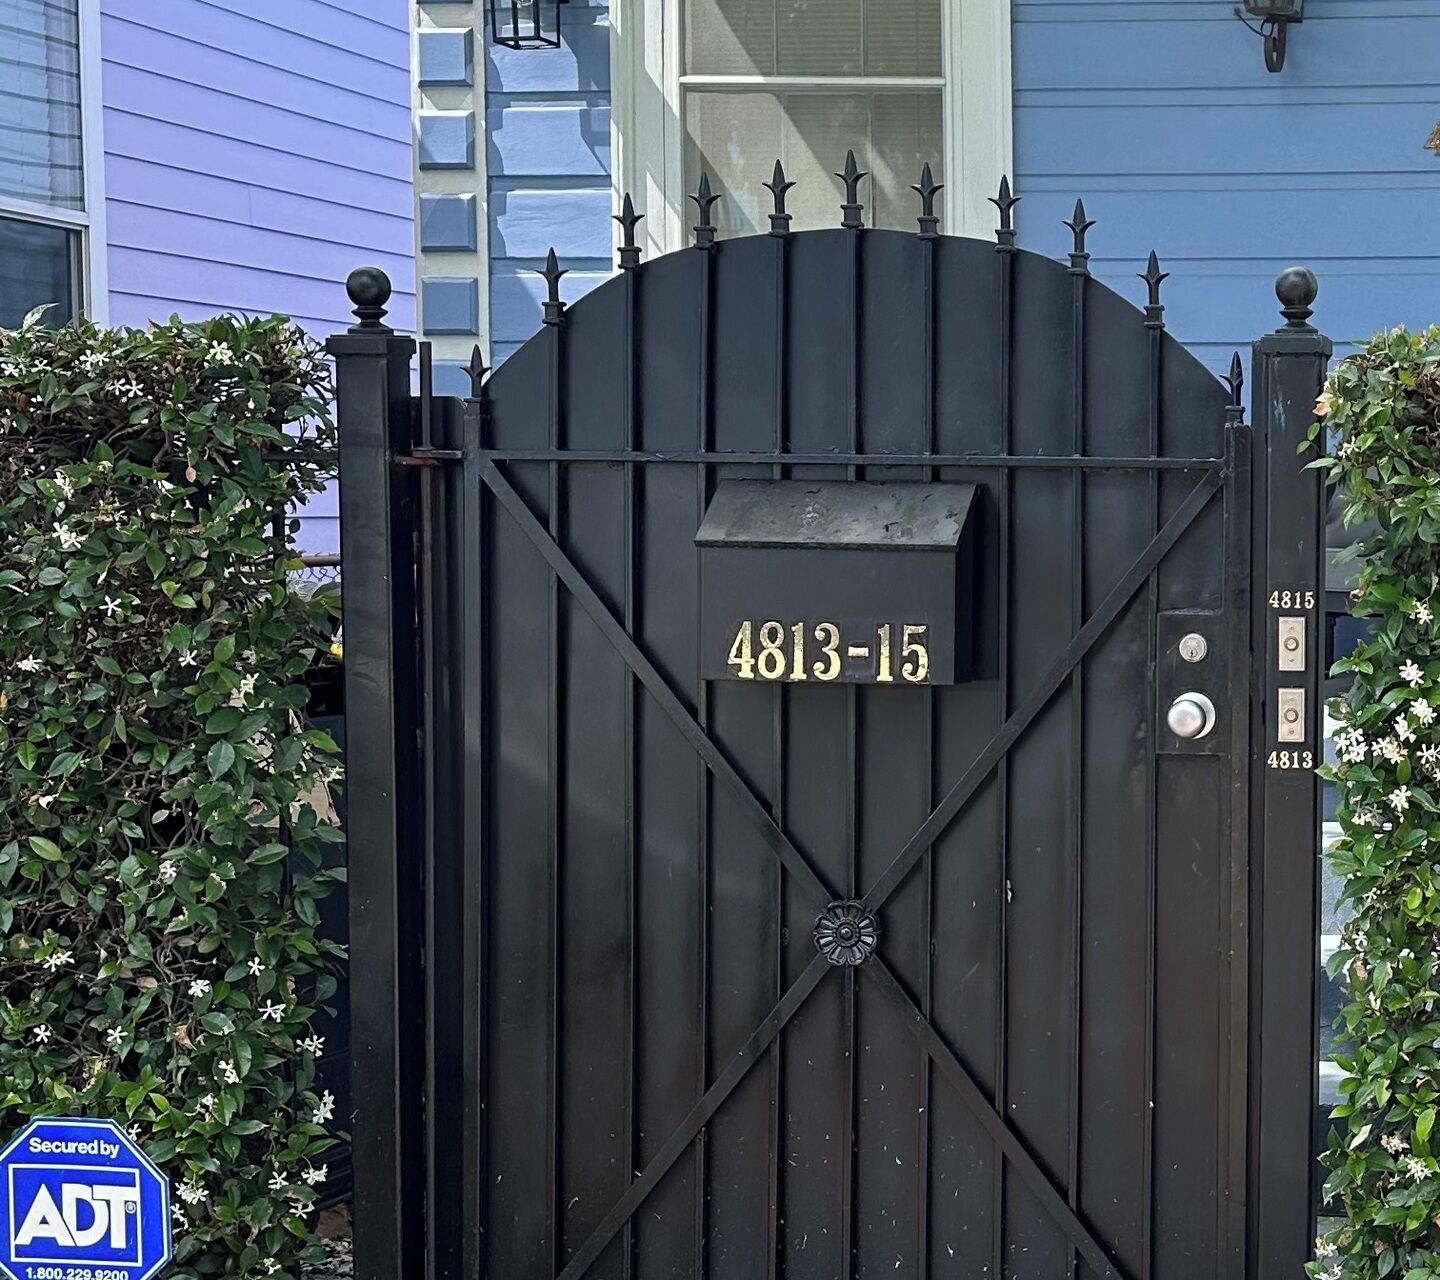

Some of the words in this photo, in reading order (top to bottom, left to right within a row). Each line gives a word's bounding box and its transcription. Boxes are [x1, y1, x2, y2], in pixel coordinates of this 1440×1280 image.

[1268, 590, 1315, 609] 4815
[727, 620, 930, 683] 4813-15
[1267, 751, 1313, 769] 4813
[29, 1137, 98, 1154] Secured
[100, 1139, 120, 1159] by
[14, 1183, 137, 1249] ADT
